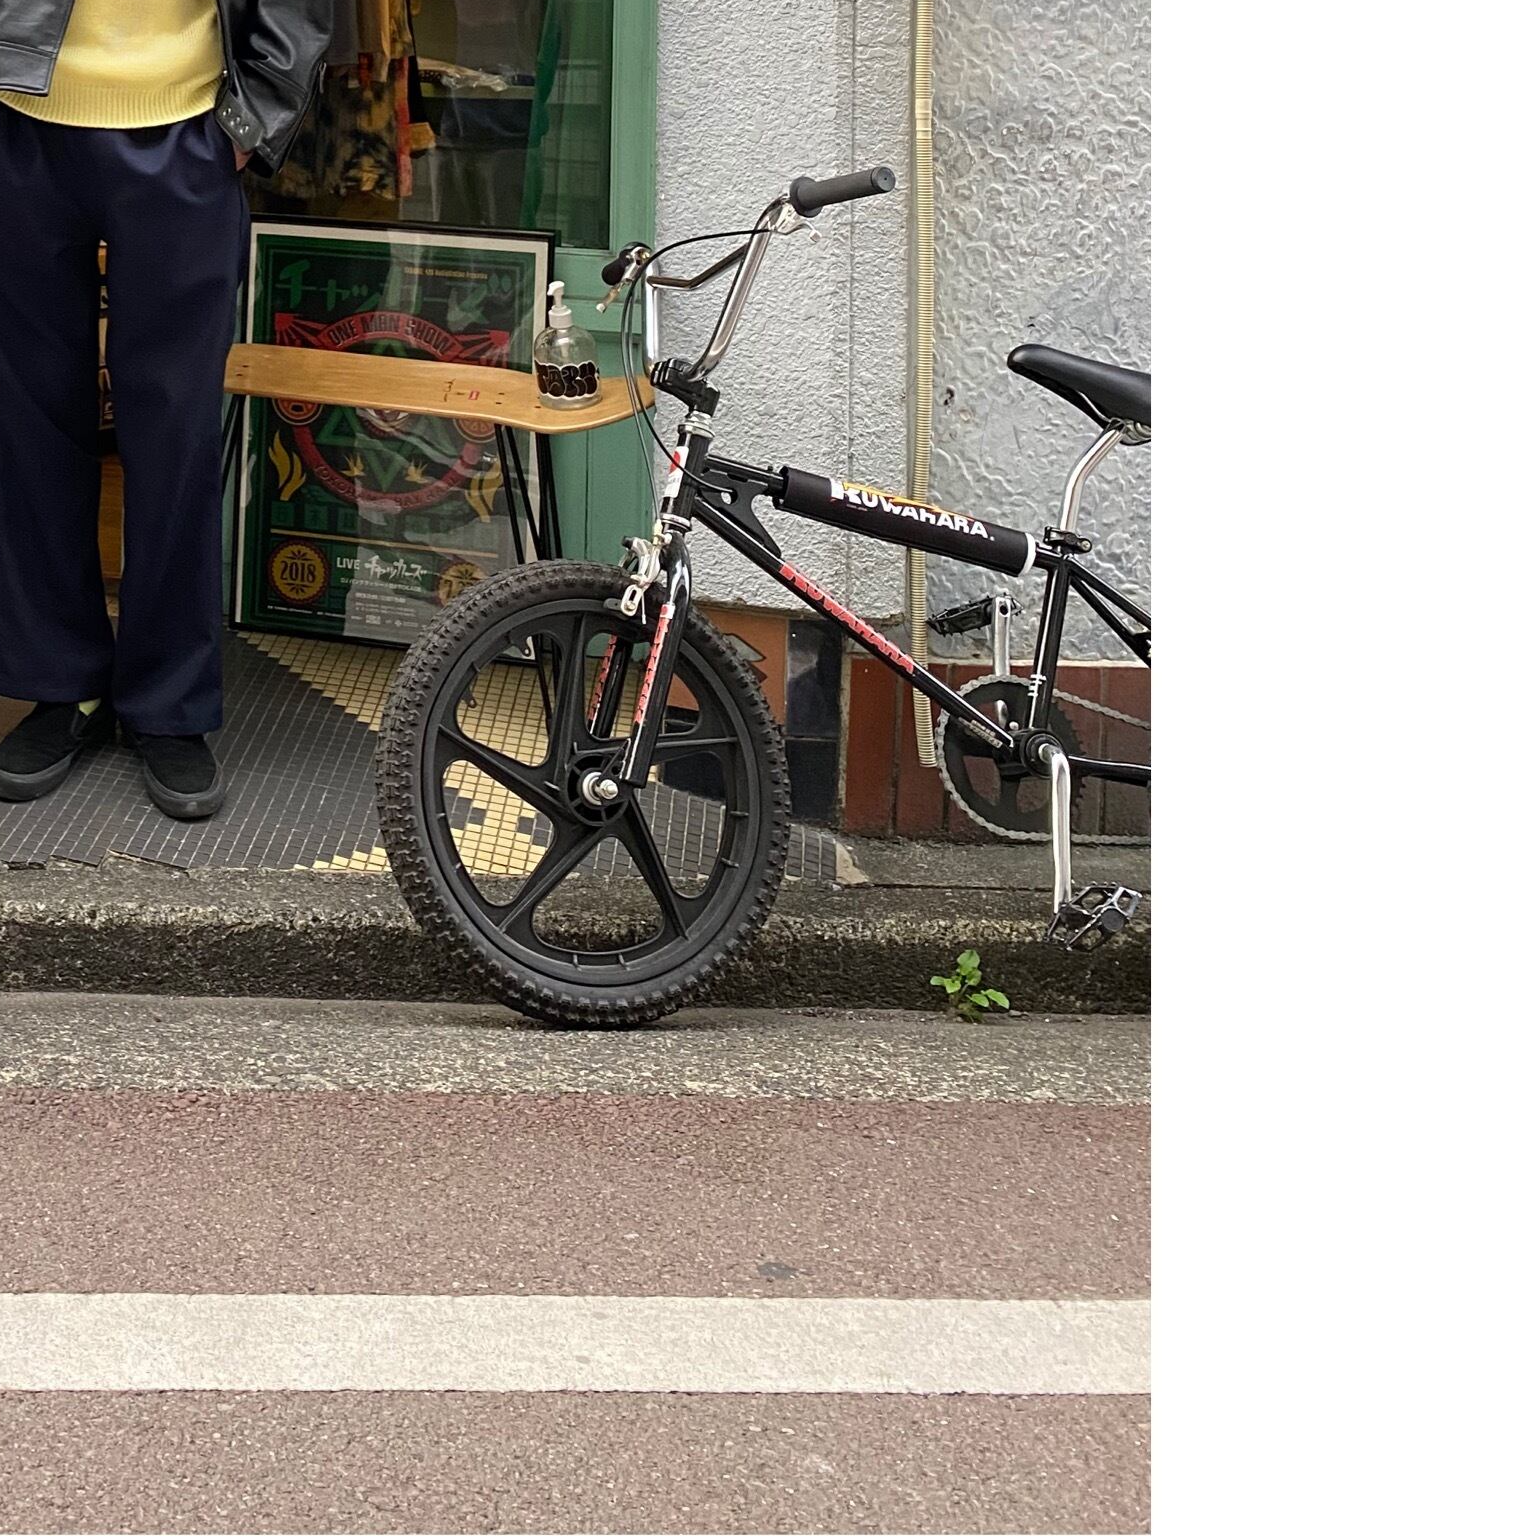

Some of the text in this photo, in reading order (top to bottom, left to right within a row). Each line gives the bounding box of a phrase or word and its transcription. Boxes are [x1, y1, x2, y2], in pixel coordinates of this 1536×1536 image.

[327, 314, 457, 356] ONE MAN SHOW
[279, 560, 316, 584] 2018
[336, 556, 361, 571] LIVE
